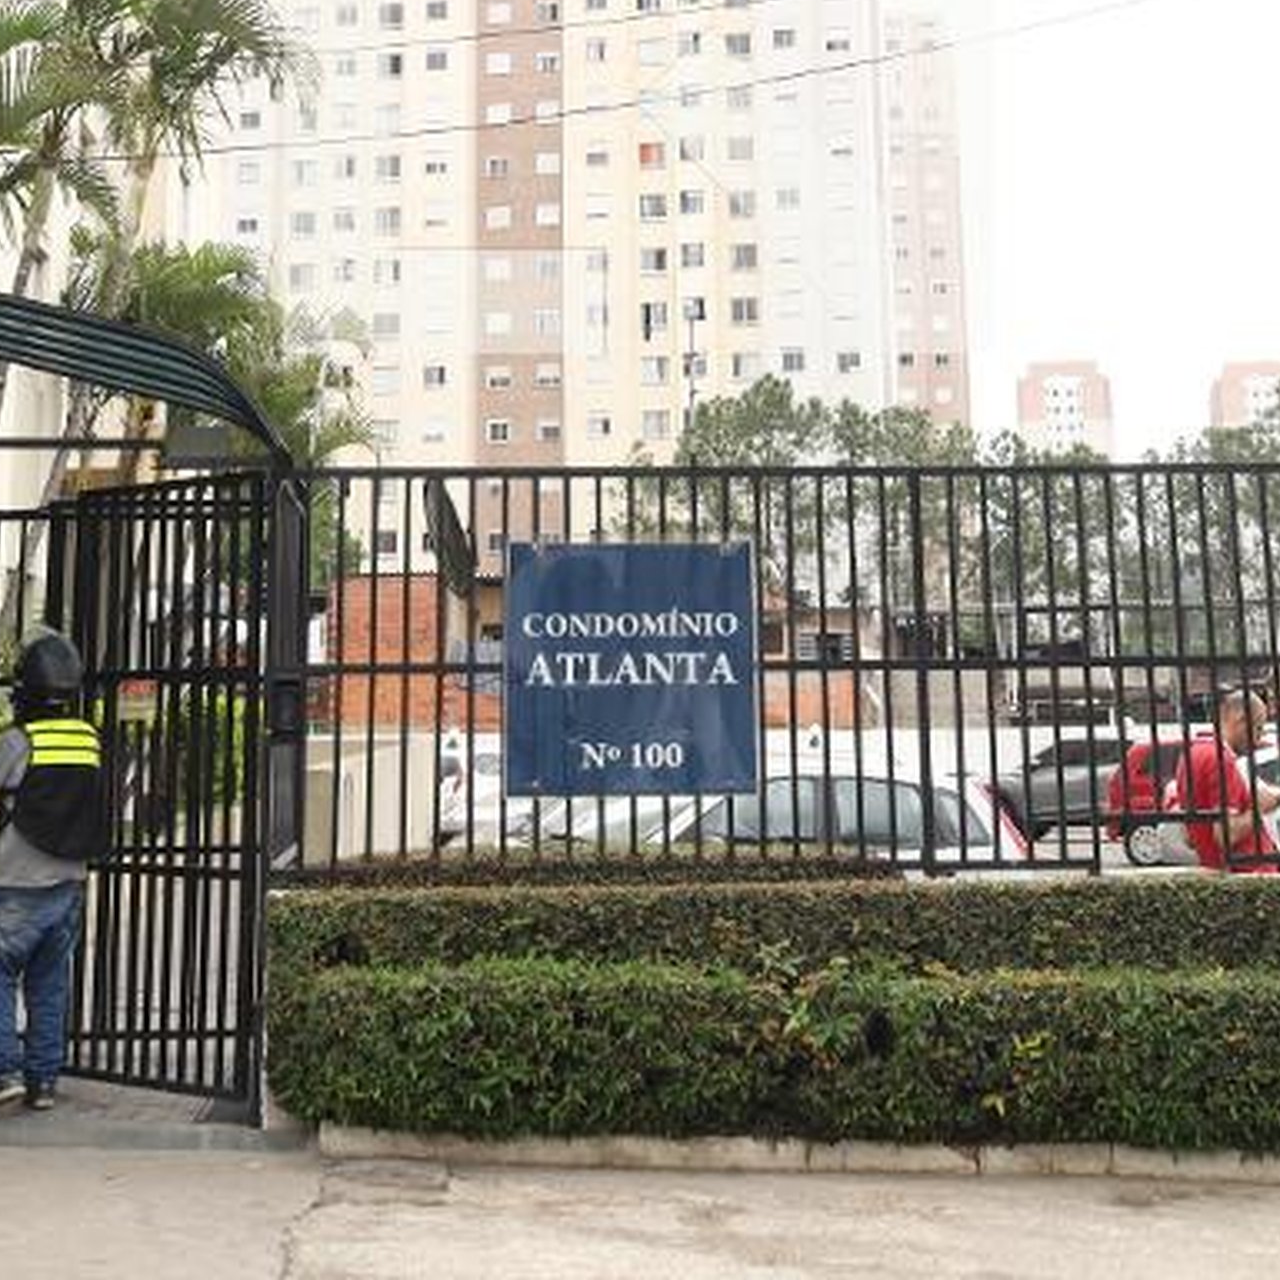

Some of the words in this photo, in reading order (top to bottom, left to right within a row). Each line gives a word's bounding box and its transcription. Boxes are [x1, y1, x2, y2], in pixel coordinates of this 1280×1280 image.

[522, 605, 738, 638] CONDOMÍNIO
[525, 652, 739, 686] ATLANTA
[632, 742, 683, 768] 100
